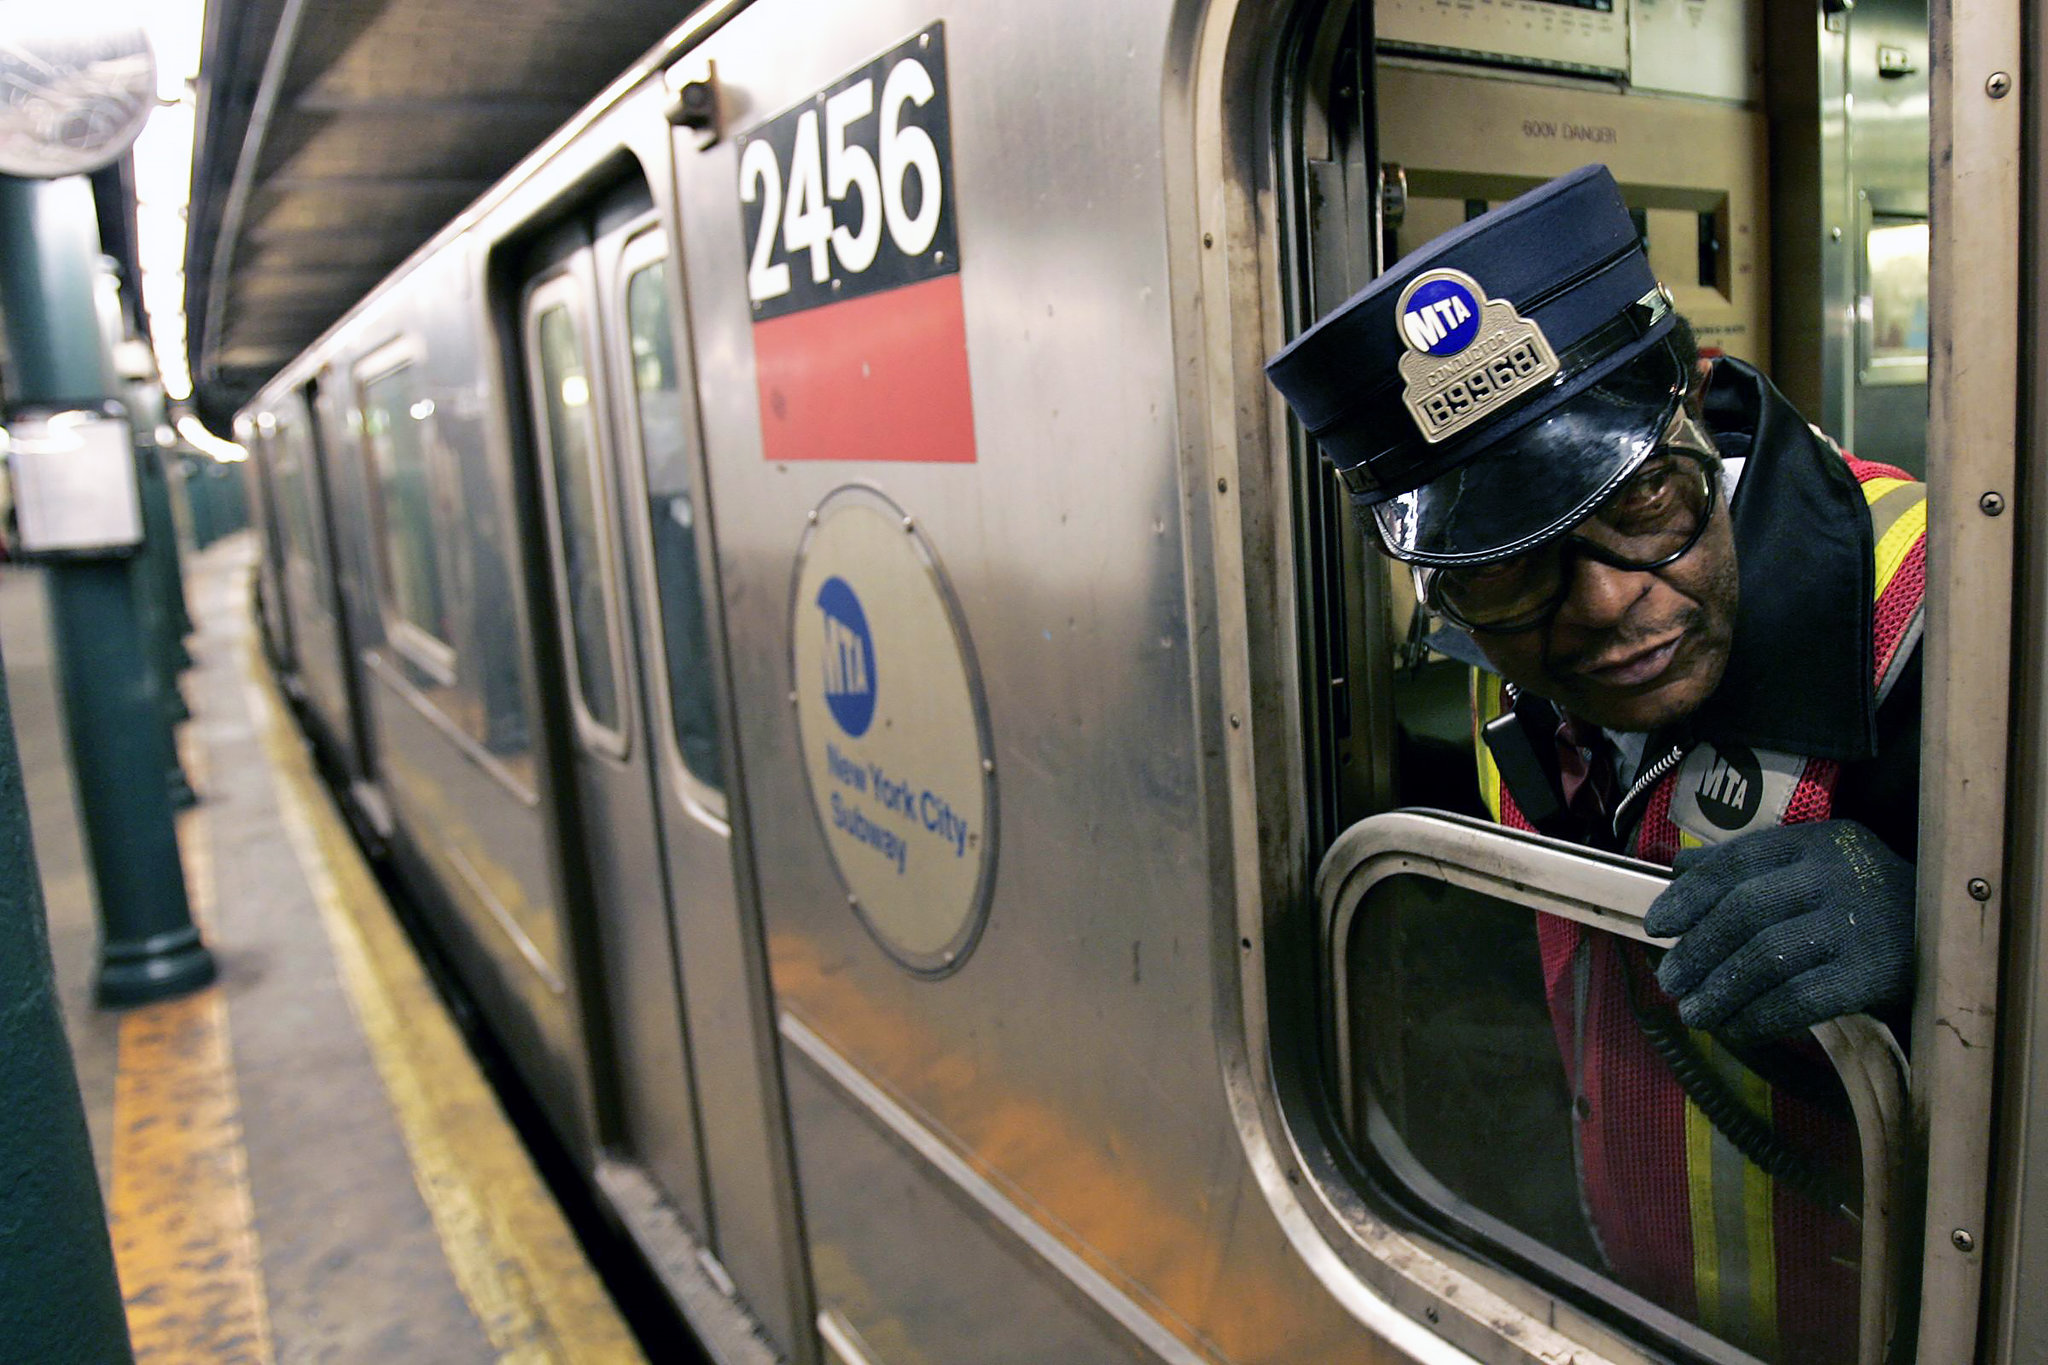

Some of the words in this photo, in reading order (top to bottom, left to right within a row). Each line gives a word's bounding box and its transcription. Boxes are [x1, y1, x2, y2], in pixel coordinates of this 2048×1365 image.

[1523, 119, 1558, 139] 600V
[1562, 123, 1618, 144] DANGER
[740, 57, 942, 301] 2456
[1403, 295, 1472, 353] MTA
[1427, 331, 1510, 387] CONDUCTOR
[1426, 344, 1538, 427] 89968
[822, 608, 869, 694] MTA
[827, 743, 867, 792] New
[870, 763, 917, 822] York
[920, 790, 967, 858] City
[1698, 752, 1748, 811] MTA
[831, 791, 907, 876] Subway
